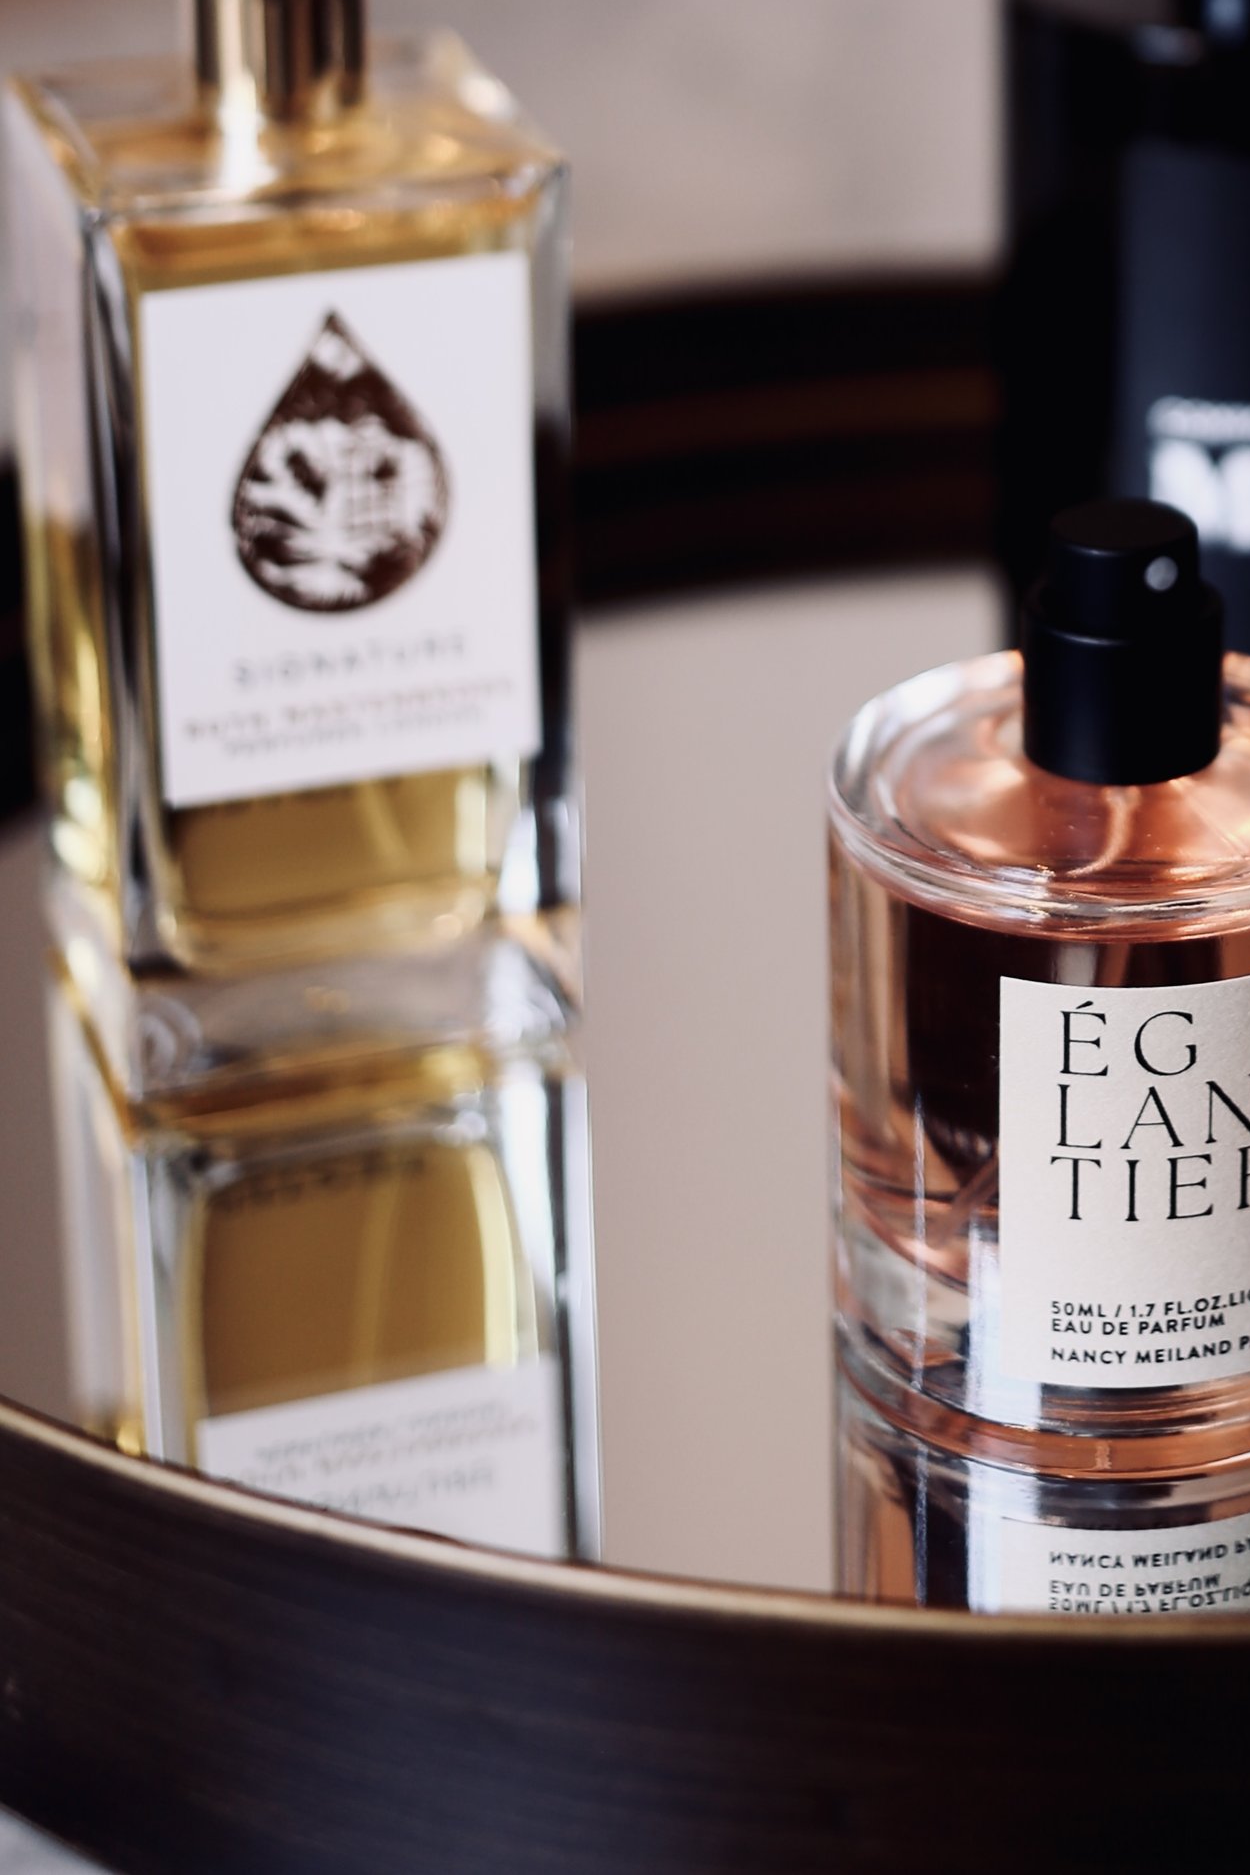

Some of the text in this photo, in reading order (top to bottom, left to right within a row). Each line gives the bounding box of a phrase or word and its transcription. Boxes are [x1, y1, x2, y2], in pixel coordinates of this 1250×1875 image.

[1059, 1000, 1197, 1077] ÉG
[1051, 1301, 1106, 1318] 50ML
[1130, 1303, 1155, 1318] 1.7
[1051, 1313, 1225, 1335] EAU DE PARFUM
[1050, 1347, 1127, 1364] NANCY
[1134, 1340, 1232, 1364] MEILAND
